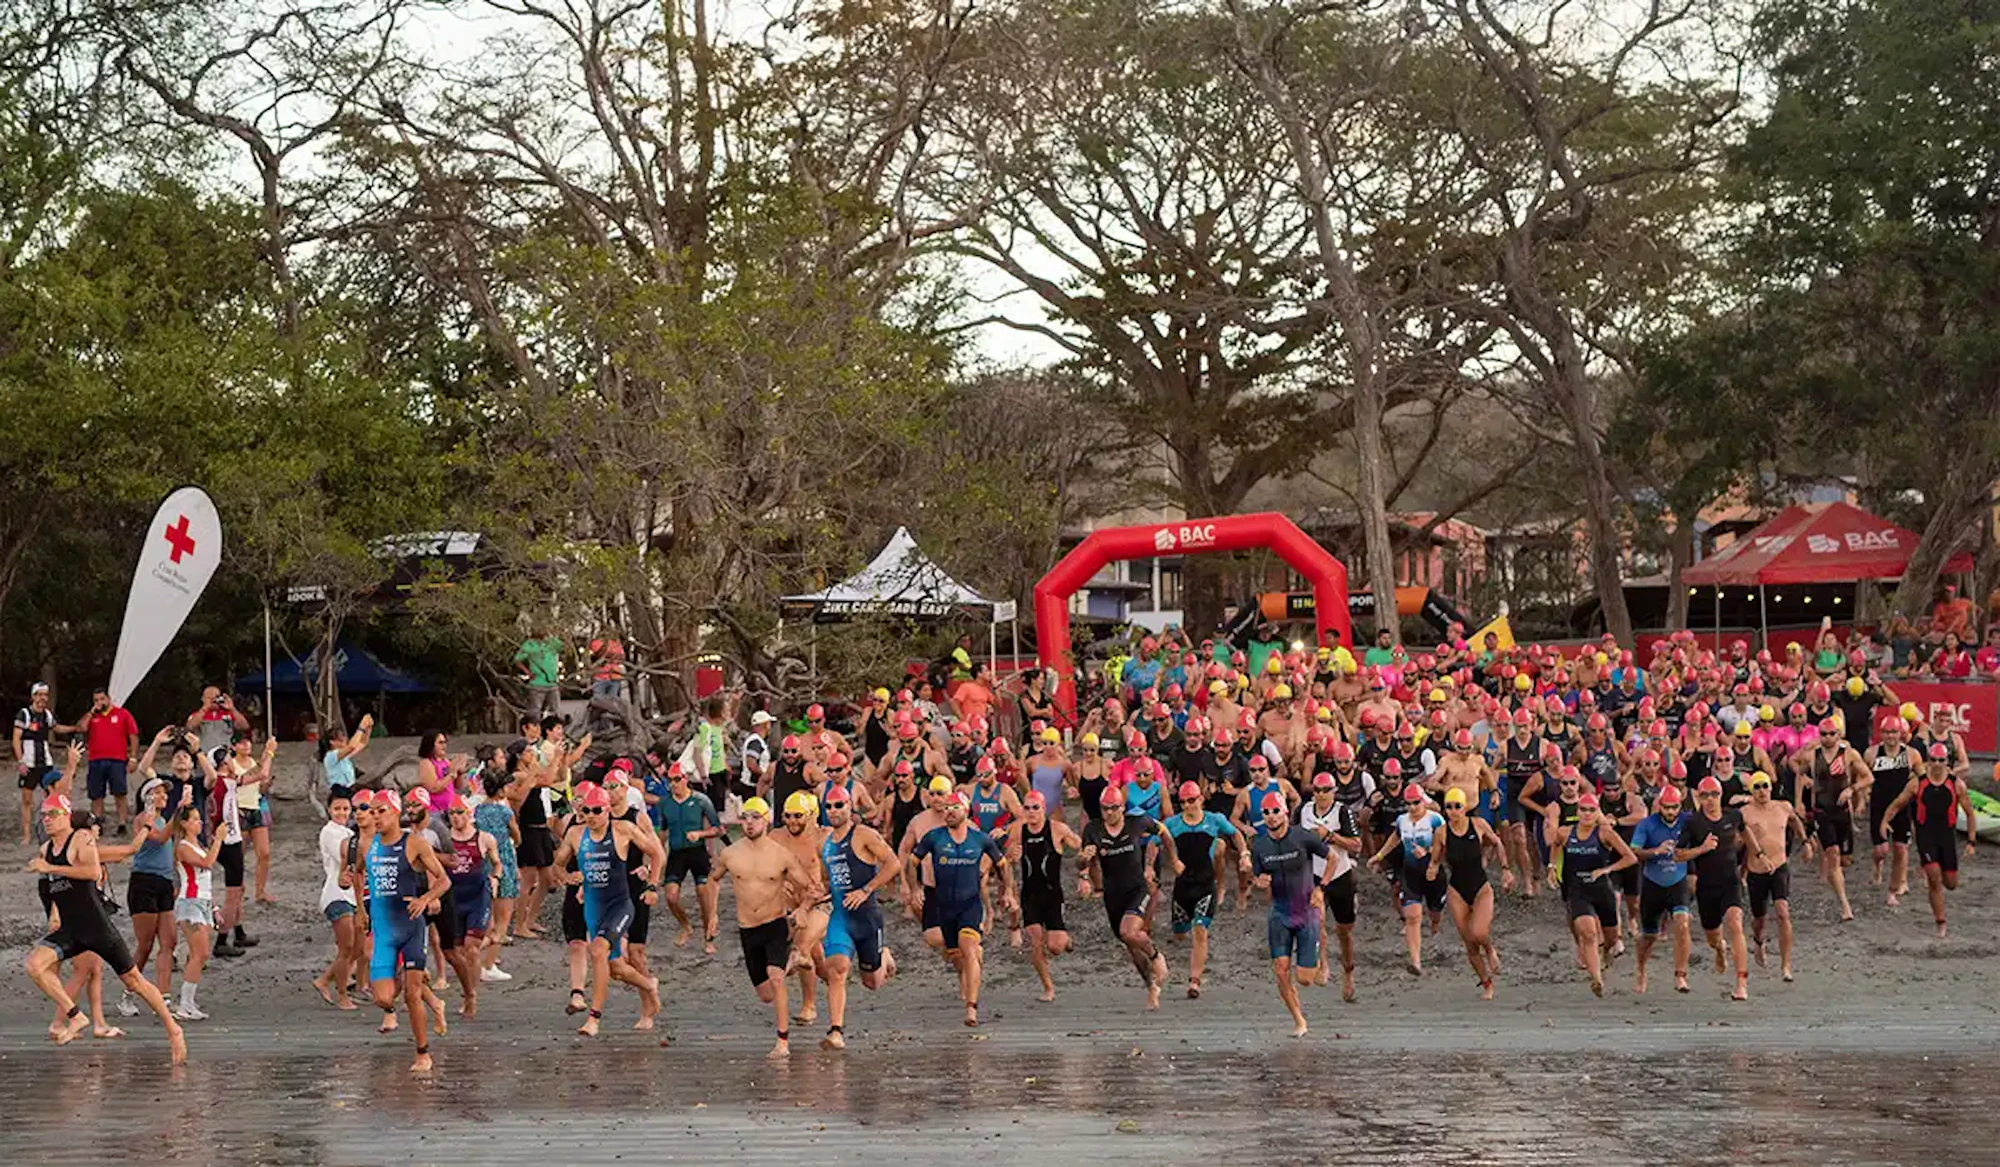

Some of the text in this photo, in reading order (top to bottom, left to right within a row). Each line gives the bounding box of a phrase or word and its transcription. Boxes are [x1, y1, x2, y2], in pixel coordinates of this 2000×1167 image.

[1180, 525, 1216, 542] BAC
[1844, 529, 1899, 546] BAC
[920, 603, 953, 615] EASY
[586, 871, 610, 882] CRC
[375, 877, 398, 889] CRC
